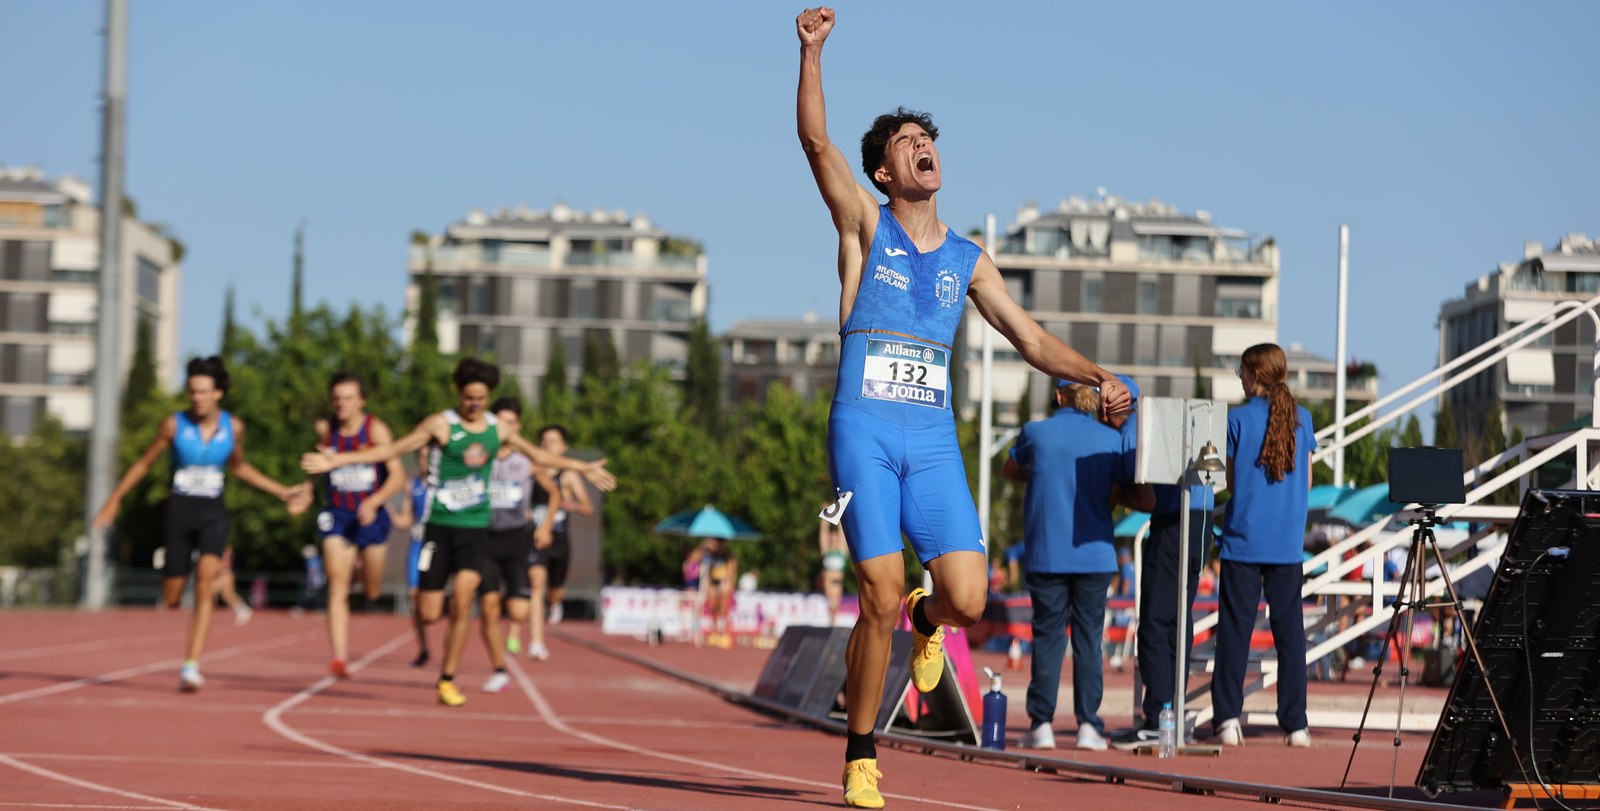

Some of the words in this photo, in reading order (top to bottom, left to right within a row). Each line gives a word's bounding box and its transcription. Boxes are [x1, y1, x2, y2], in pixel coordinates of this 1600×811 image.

[874, 272, 907, 291] APOLANA
[876, 265, 910, 284] ATLETISMO
[883, 344, 921, 358] Allianz
[889, 361, 927, 386] 132
